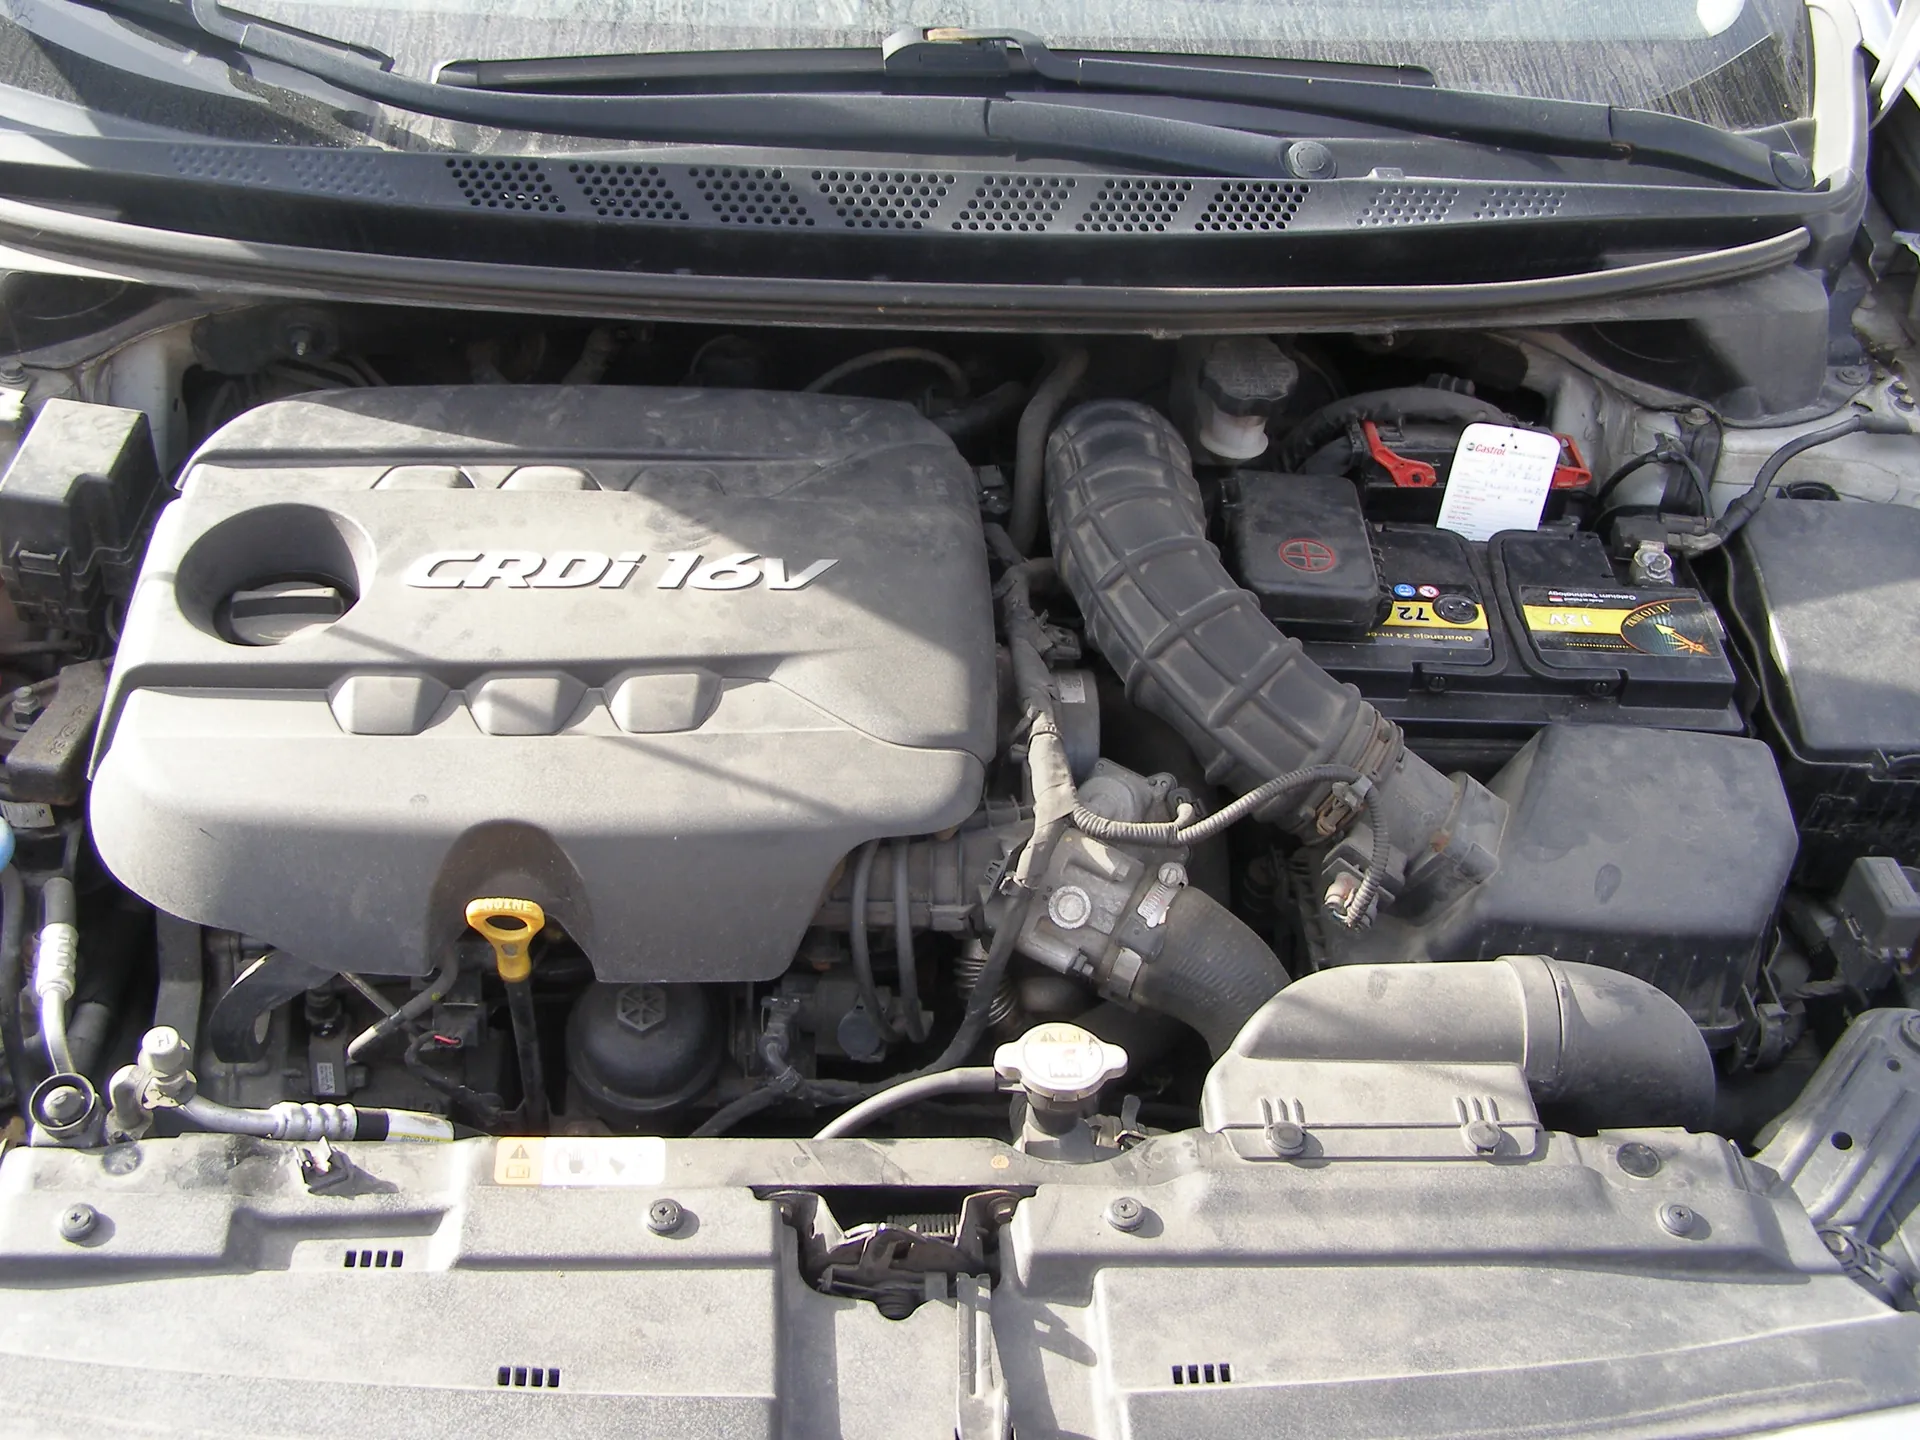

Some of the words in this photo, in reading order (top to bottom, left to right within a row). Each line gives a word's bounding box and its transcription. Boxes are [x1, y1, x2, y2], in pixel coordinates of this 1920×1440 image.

[1475, 444, 1506, 456] Castrol
[404, 551, 648, 590] CRDi
[1396, 606, 1430, 621] 72
[1550, 613, 1593, 626] 12V
[1413, 632, 1473, 642] Gwarancja
